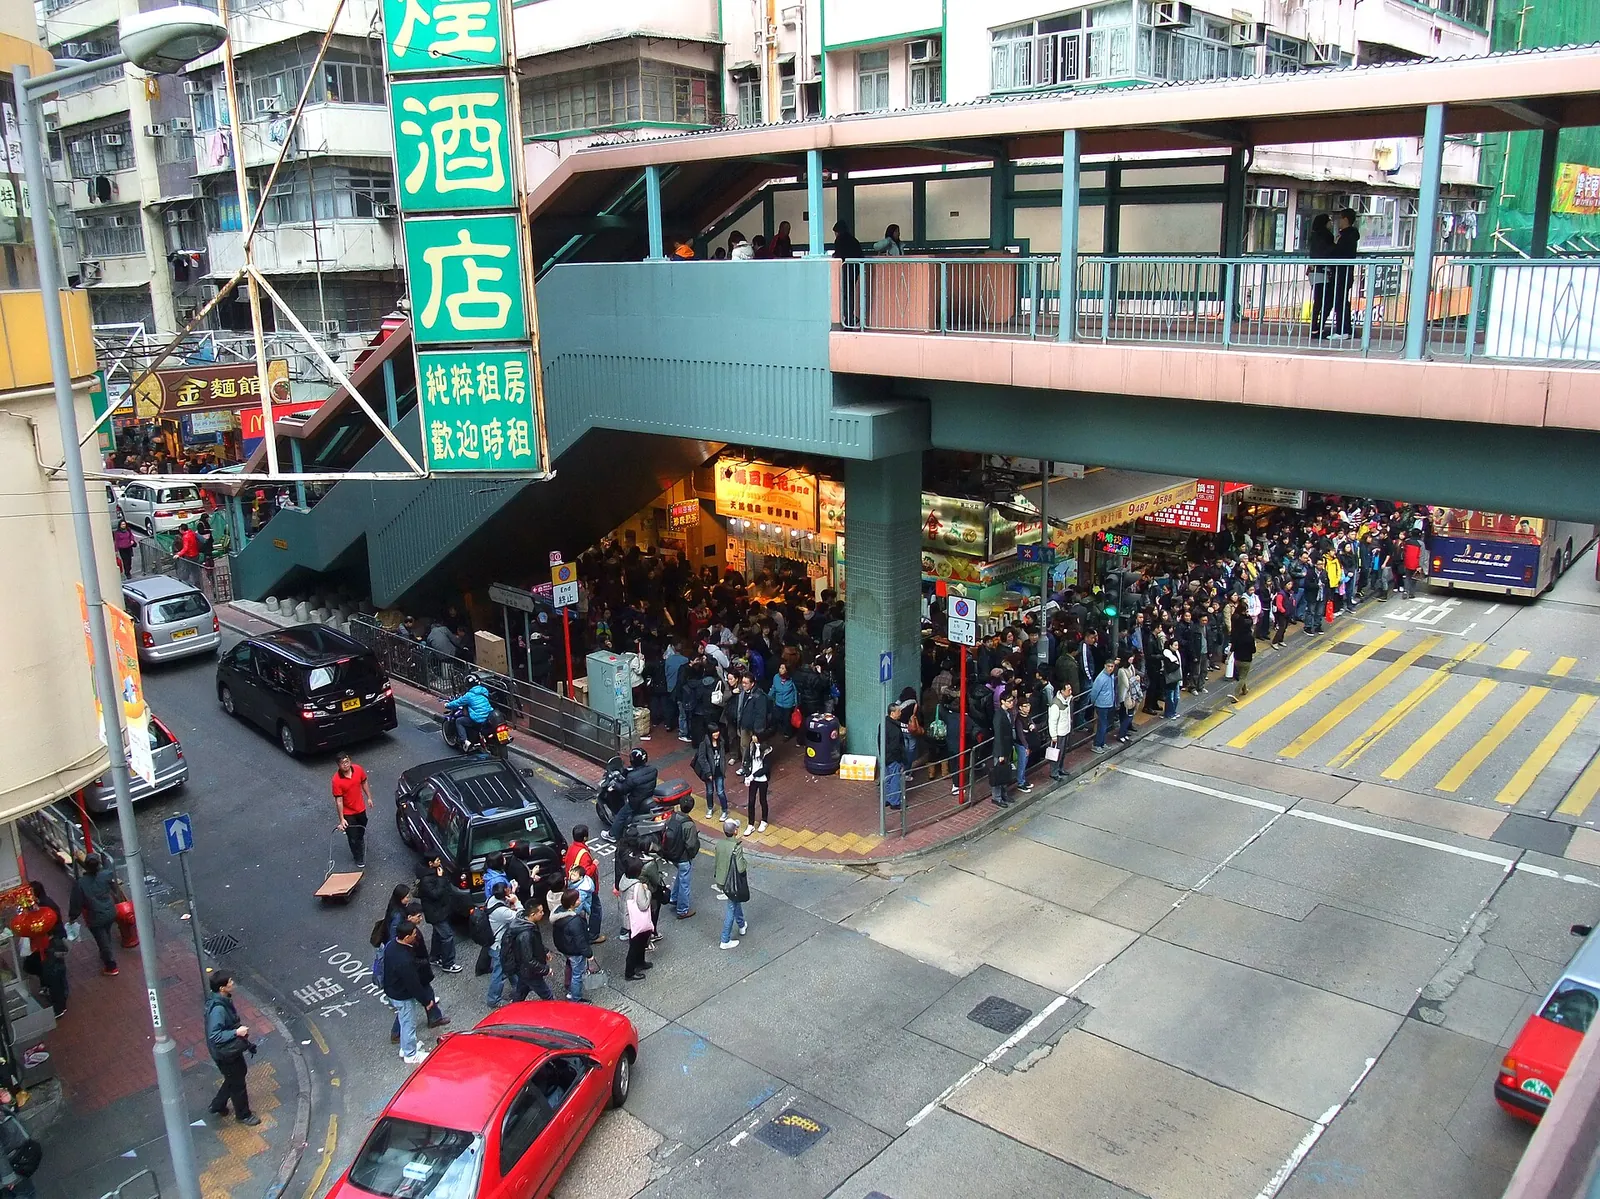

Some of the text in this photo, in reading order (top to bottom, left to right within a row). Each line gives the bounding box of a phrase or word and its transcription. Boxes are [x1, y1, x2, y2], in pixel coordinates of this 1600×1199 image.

[426, 360, 526, 406] 純粹租房
[431, 417, 532, 461] 歡迎時租
[1128, 501, 1150, 516] 9487
[1153, 493, 1173, 507] 4588
[560, 585, 571, 593] End
[965, 635, 974, 644] 12
